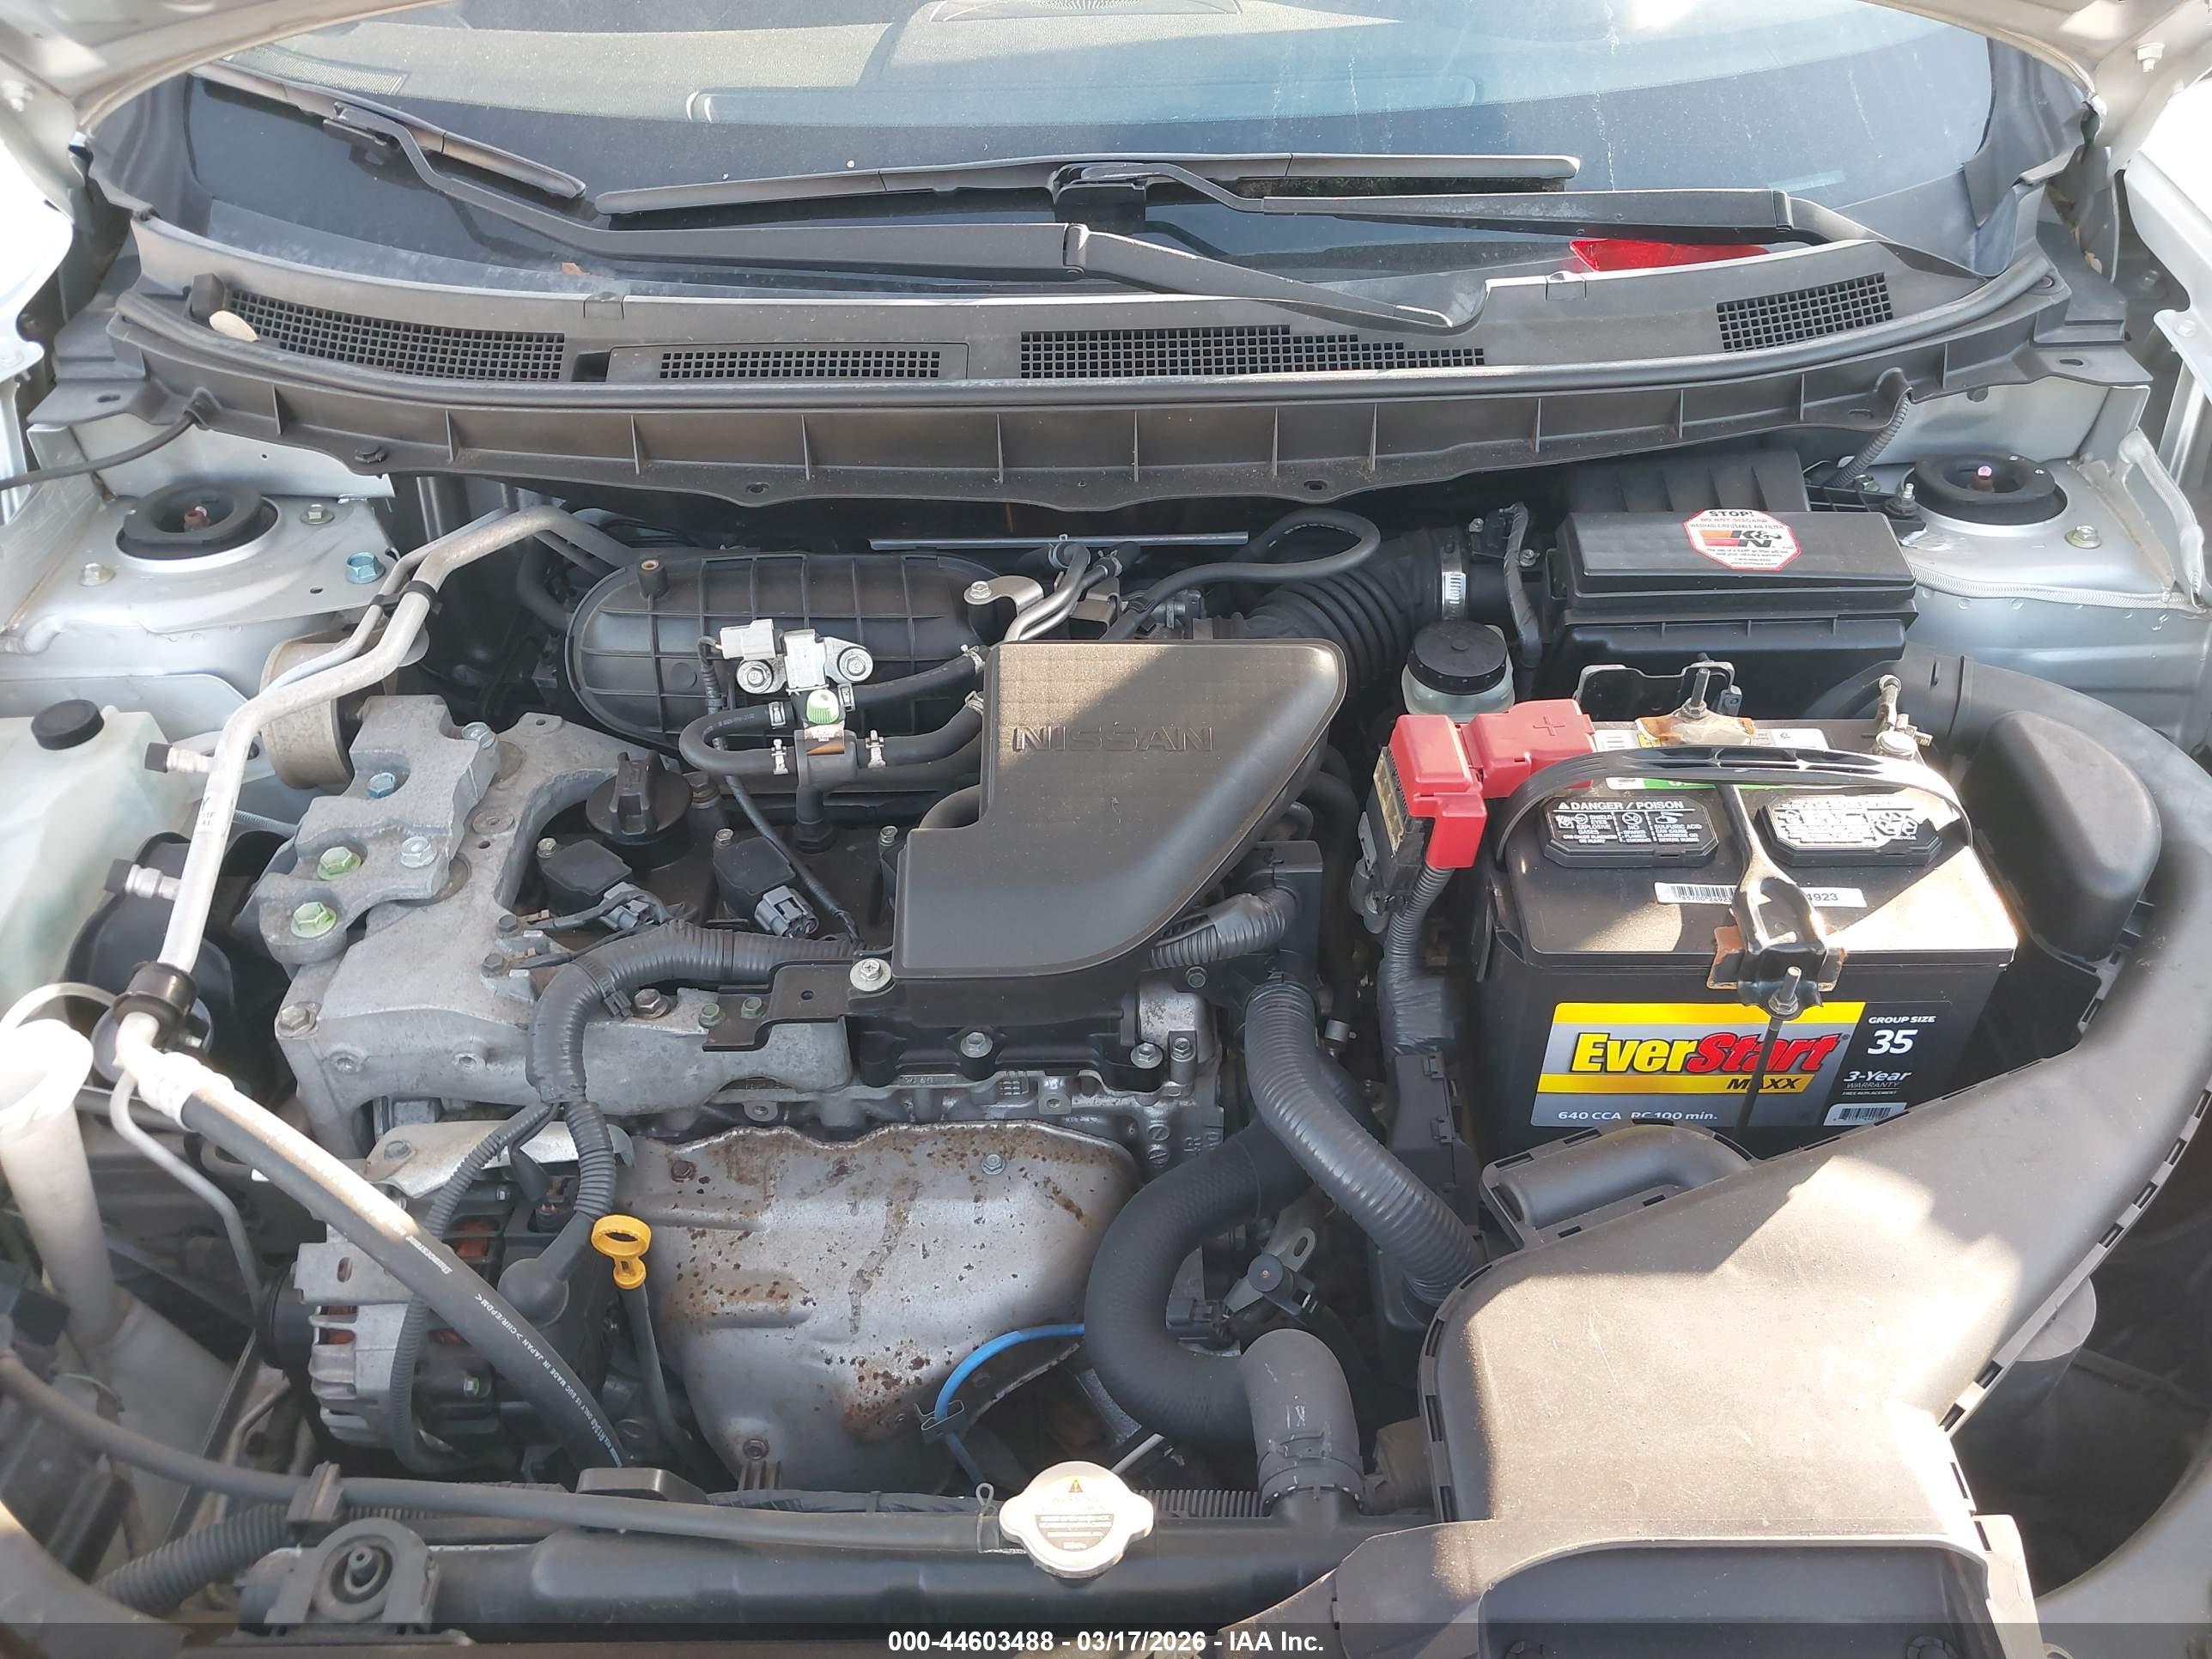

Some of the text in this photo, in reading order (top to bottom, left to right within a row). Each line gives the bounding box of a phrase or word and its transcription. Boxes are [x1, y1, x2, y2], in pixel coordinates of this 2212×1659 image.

[1013, 726, 1213, 752] NISSAN
[1571, 801, 1624, 811] DANGER
[1635, 800, 1684, 810] POISON
[1867, 1029, 1918, 1055] 35
[1570, 1032, 1841, 1073] EverStart
[1843, 1070, 1912, 1082] 3-Year
[1558, 1111, 1589, 1120] 640
[1591, 1111, 1621, 1120] CCA
[1655, 1111, 1683, 1120] 100
[1685, 1109, 1717, 1120] min.
[522, 1339, 544, 1360] JAPAN
[542, 1359, 551, 1370] IN
[550, 1367, 567, 1387] MADE
